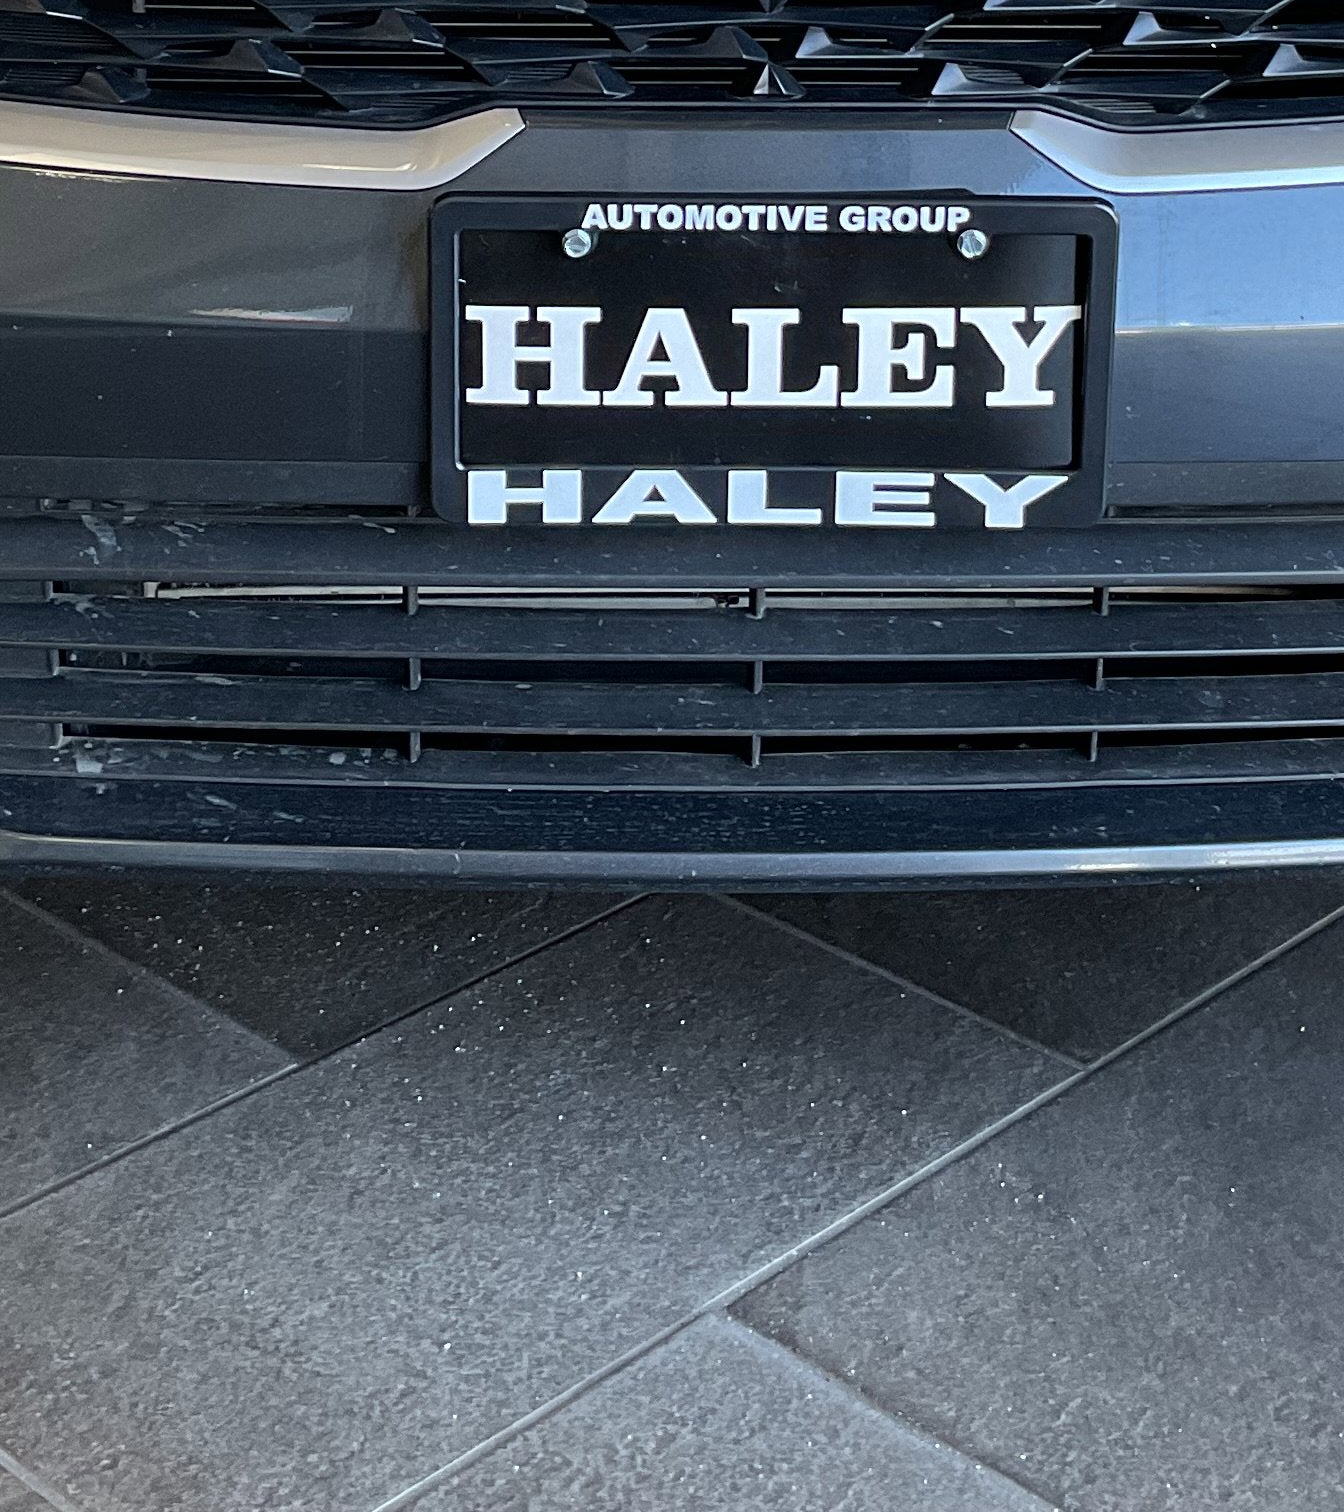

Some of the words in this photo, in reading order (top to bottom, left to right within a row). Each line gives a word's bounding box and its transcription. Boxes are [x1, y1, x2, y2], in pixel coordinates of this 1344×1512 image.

[581, 203, 828, 232] AUTOMOTIVE
[839, 205, 971, 233] GROUP
[464, 305, 1082, 408] HALEY
[466, 469, 1069, 529] HALEY
